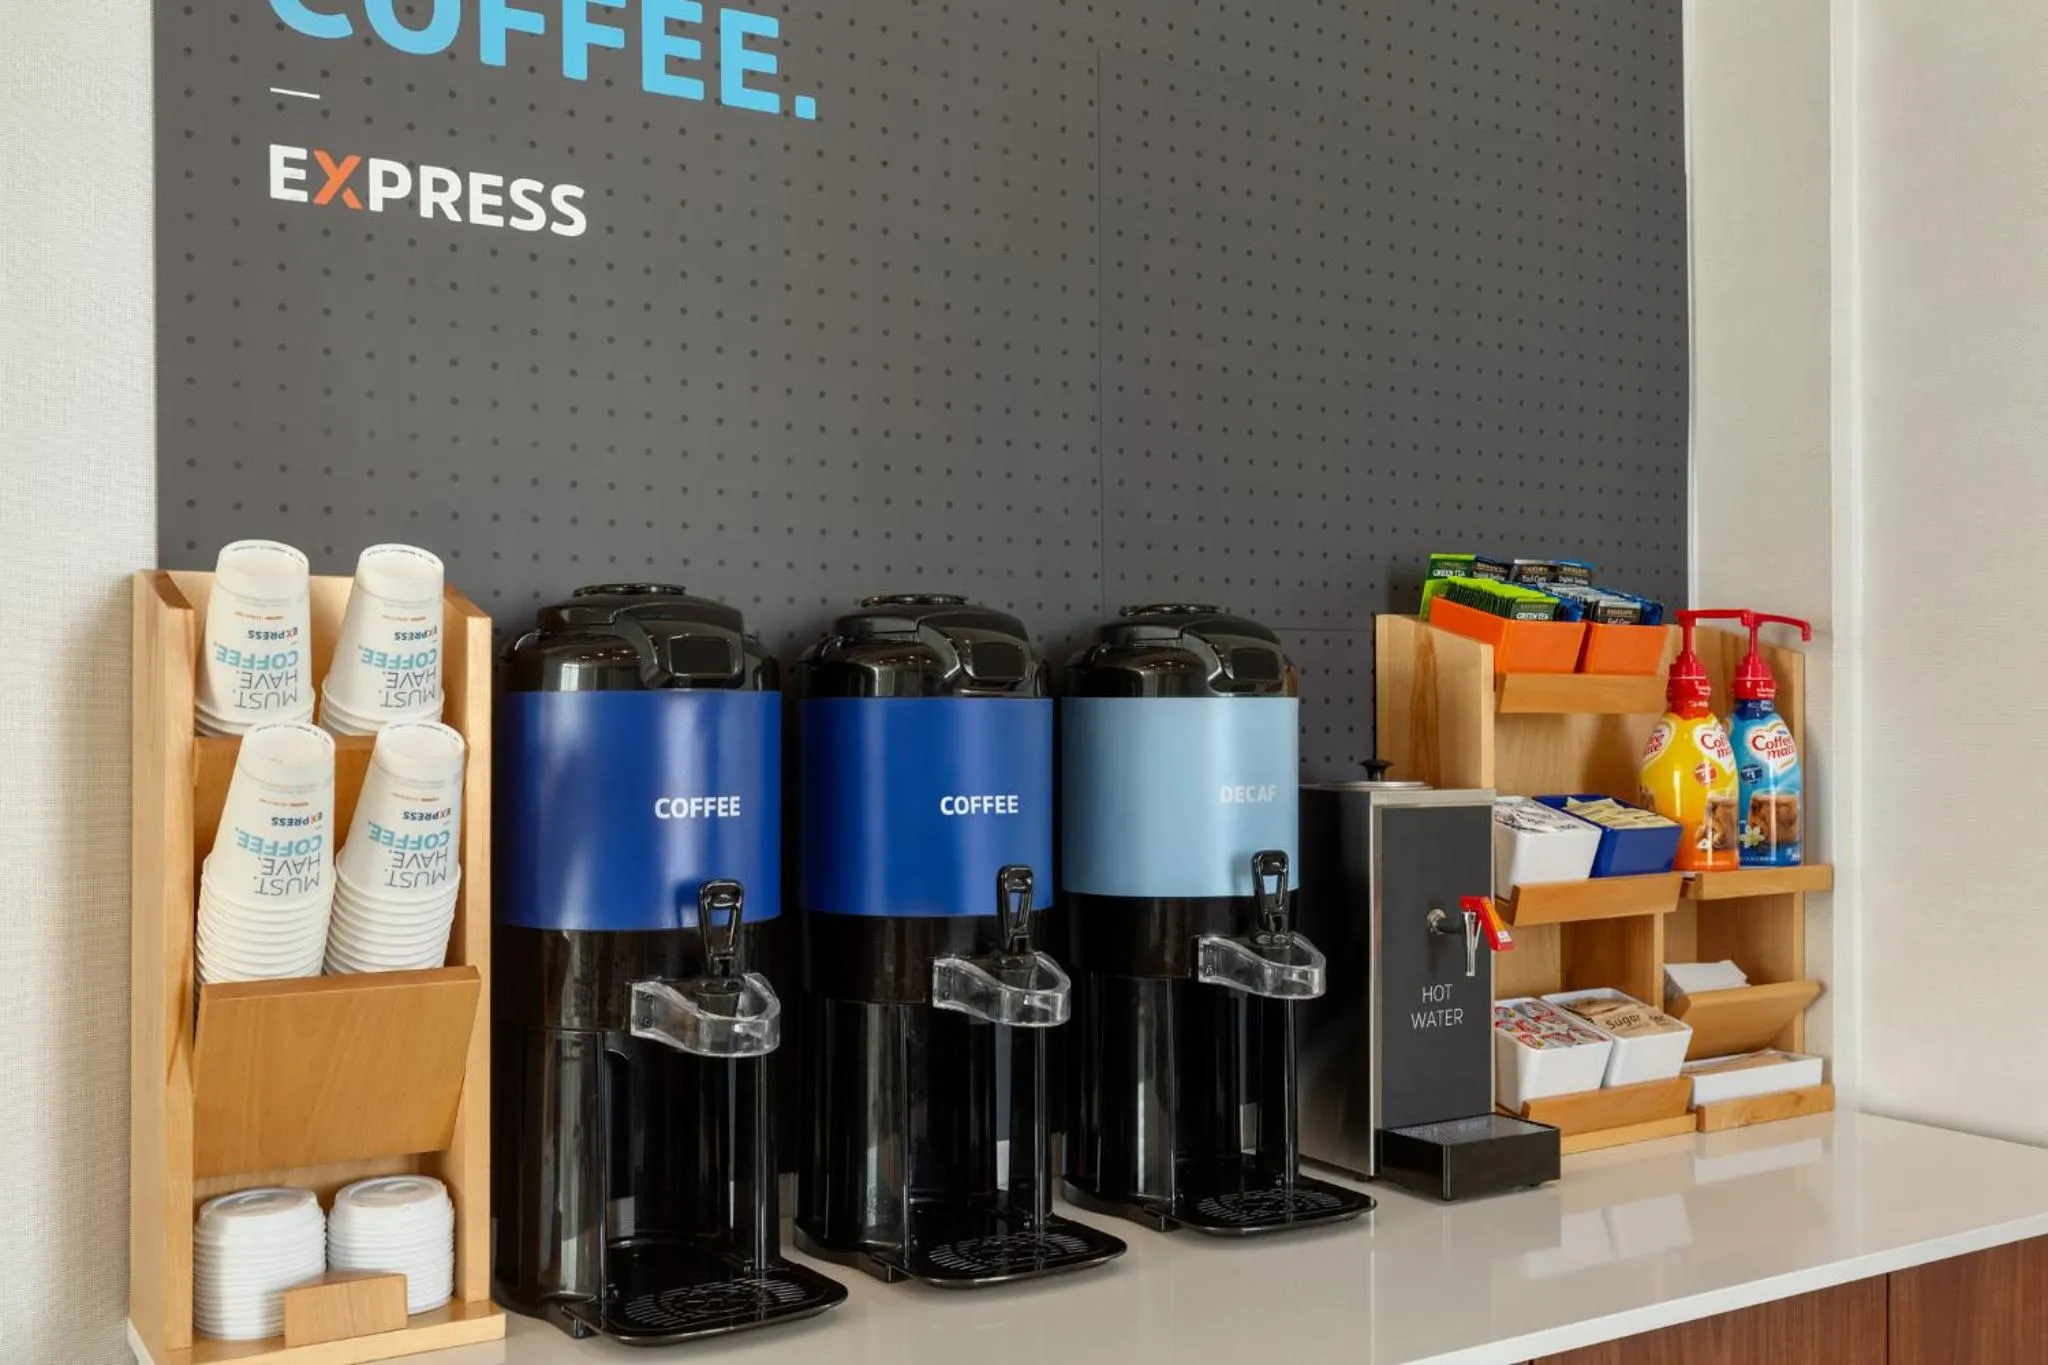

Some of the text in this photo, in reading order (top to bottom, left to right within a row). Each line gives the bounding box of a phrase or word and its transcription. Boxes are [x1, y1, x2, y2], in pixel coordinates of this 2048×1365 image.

[269, 143, 587, 237] EXPRESS
[248, 627, 298, 640] EXPRESS
[394, 626, 438, 641] EXPRESS
[213, 642, 298, 670] COFFEE.
[358, 645, 438, 670] COFFEE.
[236, 669, 298, 689] HAVE.
[381, 666, 436, 689] HAVE.
[233, 687, 297, 709] MUST.
[378, 687, 435, 708] MUST.
[1220, 784, 1277, 803] DECAF
[403, 808, 451, 821] EXPRESS
[655, 796, 740, 819] COFFEE
[940, 795, 1018, 815] COFFEE
[271, 811, 323, 827] EXPRESS
[235, 827, 323, 857] COFFEE.
[367, 820, 450, 851] COFFEE.
[258, 855, 320, 877] HAVE.
[388, 847, 448, 870] HAVE.
[253, 874, 319, 897] MUST.
[384, 867, 446, 888] MUST.
[1422, 984, 1453, 1003] HOT
[1410, 1008, 1464, 1029] WATER
[1605, 1013, 1640, 1030] Sugar
